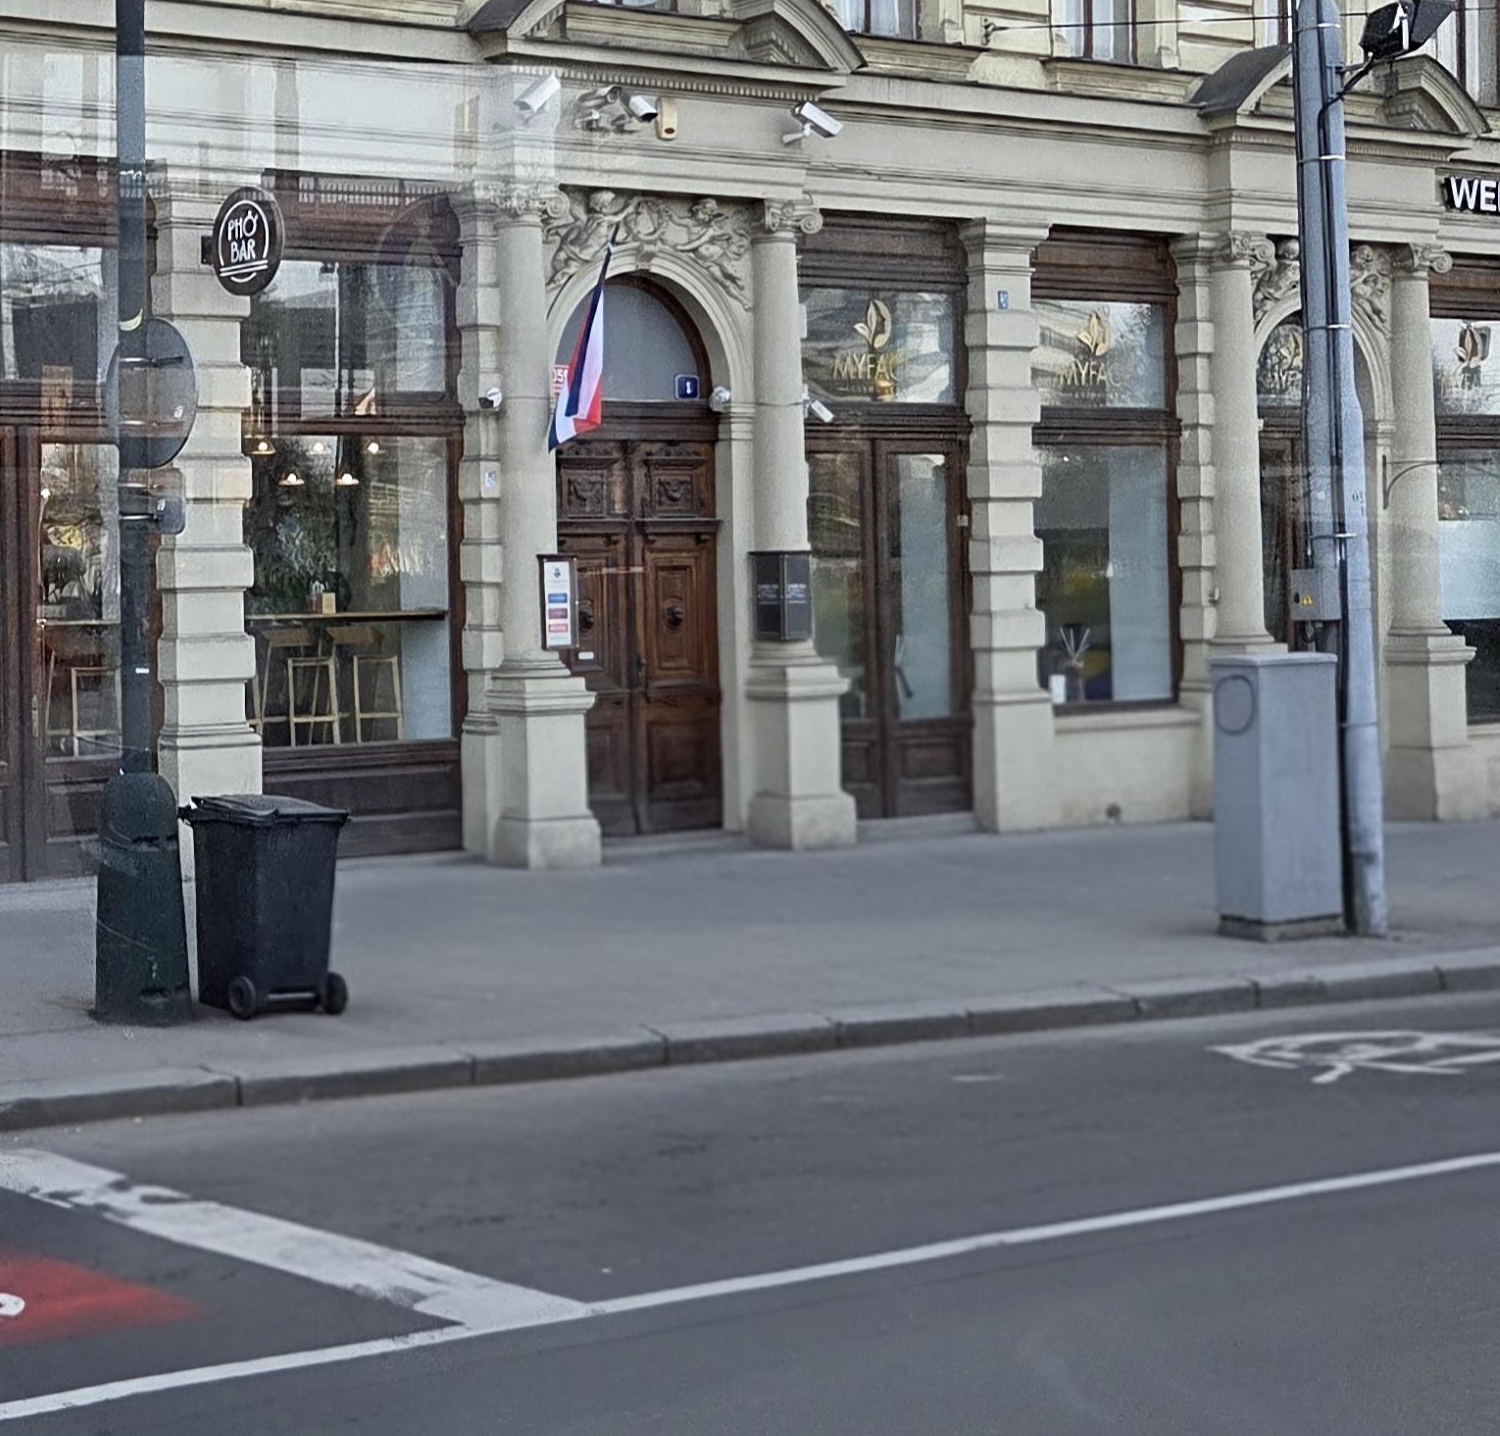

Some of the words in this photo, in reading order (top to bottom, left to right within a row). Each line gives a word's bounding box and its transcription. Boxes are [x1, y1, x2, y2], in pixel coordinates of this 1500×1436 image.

[1450, 176, 1500, 212] WE
[231, 238, 256, 263] BAR
[685, 381, 692, 395] 1
